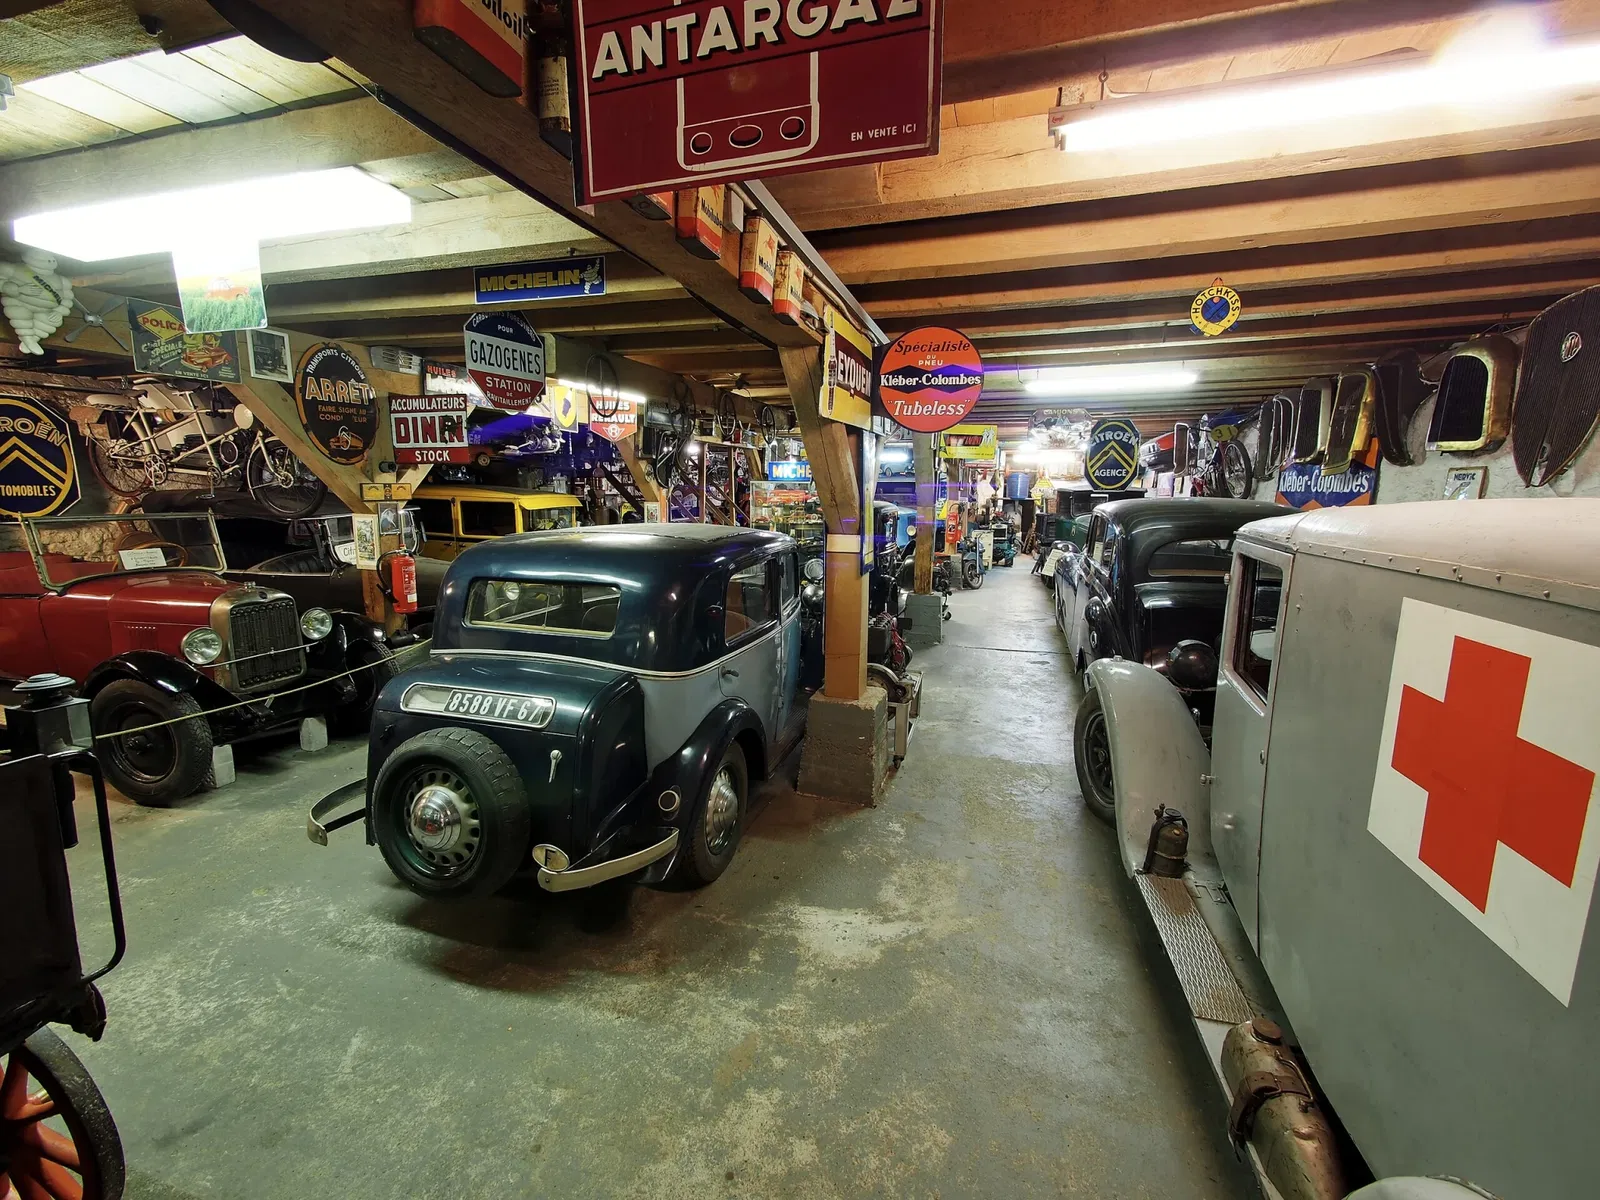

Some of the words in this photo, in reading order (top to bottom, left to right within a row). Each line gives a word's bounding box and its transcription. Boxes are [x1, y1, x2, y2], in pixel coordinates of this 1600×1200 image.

[851, 132, 863, 142] EN
[868, 127, 897, 139] VENTE
[902, 123, 917, 134] ICI
[480, 269, 580, 292] MICHELIN
[1192, 287, 1240, 314] HOTCHKISS
[497, 324, 514, 334] POUR
[895, 340, 970, 355] Spécialiste
[306, 348, 339, 374] TRANSPORTS
[470, 340, 541, 375] GAZOGENES
[427, 365, 457, 378] HUILES
[485, 376, 531, 393] STATION
[880, 373, 982, 386] Kléber-Colombes
[391, 397, 465, 411] ACCUMULATEURS
[486, 390, 532, 406] RAVITAILLEMENT
[318, 405, 336, 413] FAIRE
[338, 407, 358, 415] SIGNE
[1215, 426, 1233, 439] 31
[415, 450, 450, 462] STOCK
[1094, 468, 1127, 477] AGENCE
[449, 692, 493, 716] 8588
[493, 697, 519, 718] VF
[544, 849, 556, 867] F
